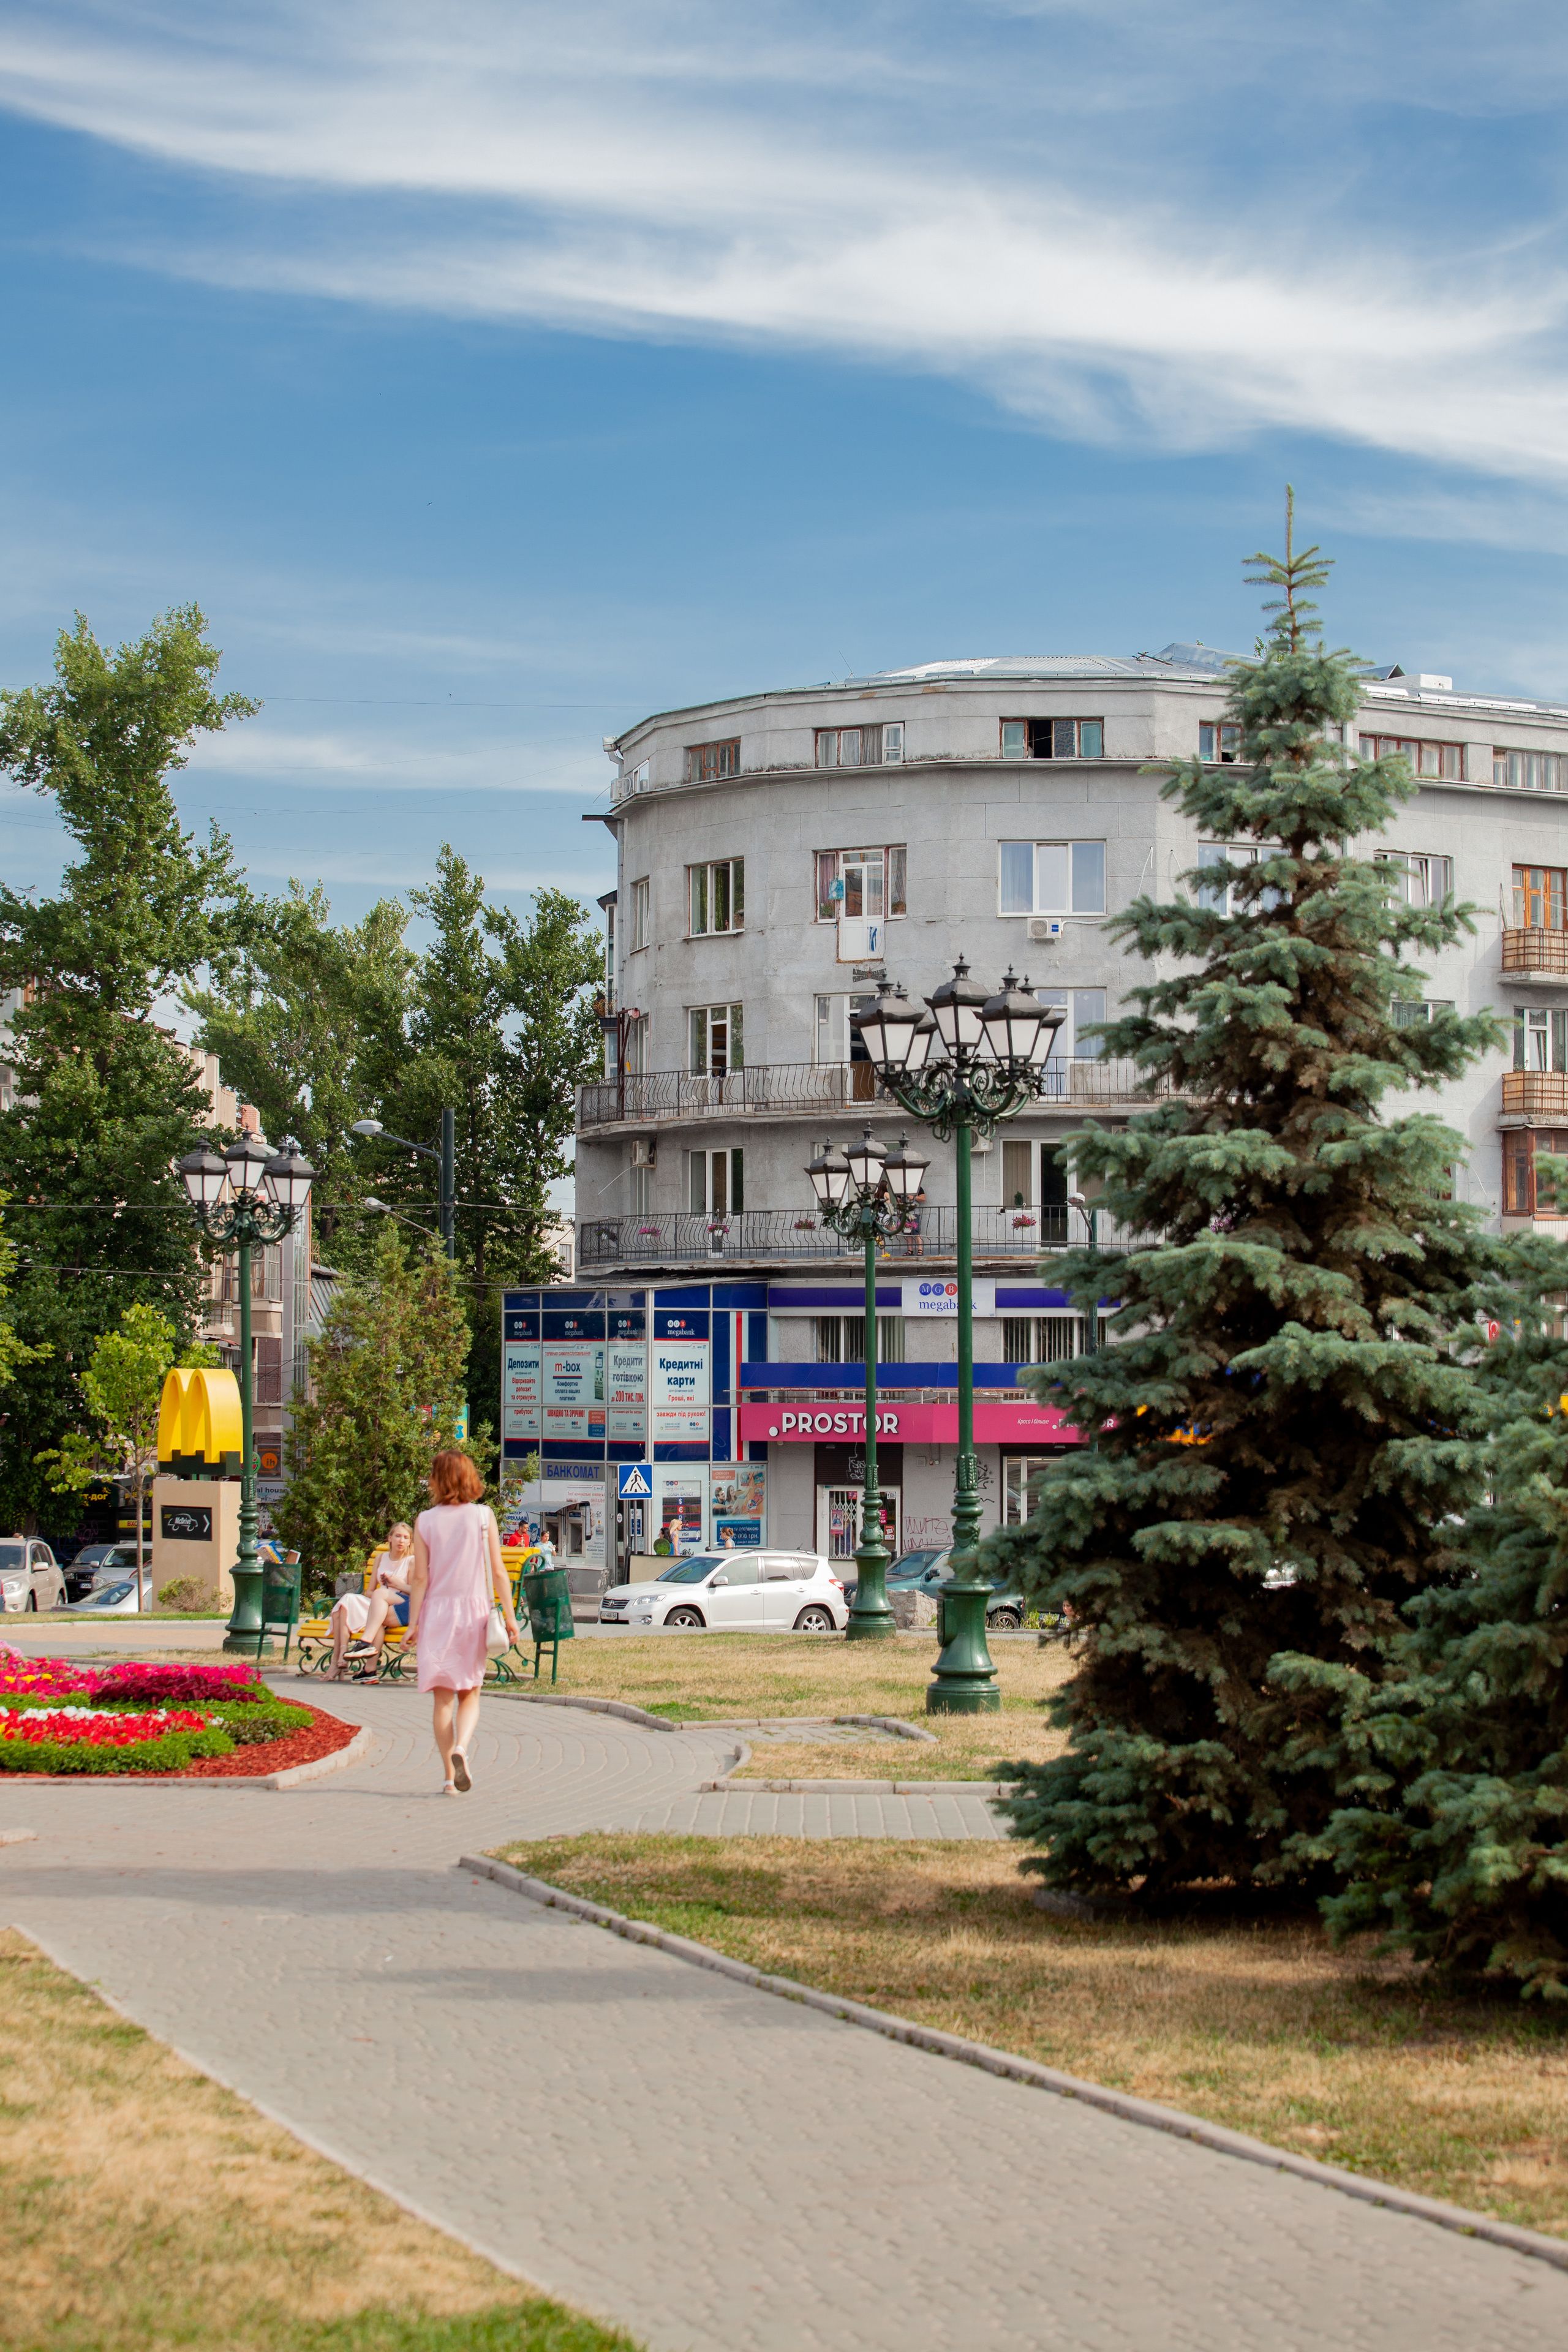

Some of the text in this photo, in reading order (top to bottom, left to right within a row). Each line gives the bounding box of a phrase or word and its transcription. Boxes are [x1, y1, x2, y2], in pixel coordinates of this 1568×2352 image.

[919, 1299, 978, 1311] megabk
[508, 1358, 539, 1370] Депозити
[555, 1360, 581, 1371] m-box
[614, 1355, 643, 1368] Кредити
[660, 1358, 703, 1371] Кредитні
[613, 1371, 643, 1382] готівкою
[667, 1377, 695, 1387] карти
[616, 1391, 624, 1402] 200
[547, 1465, 600, 1479] БАНКОМАТ
[174, 1516, 192, 1525] McDrive
